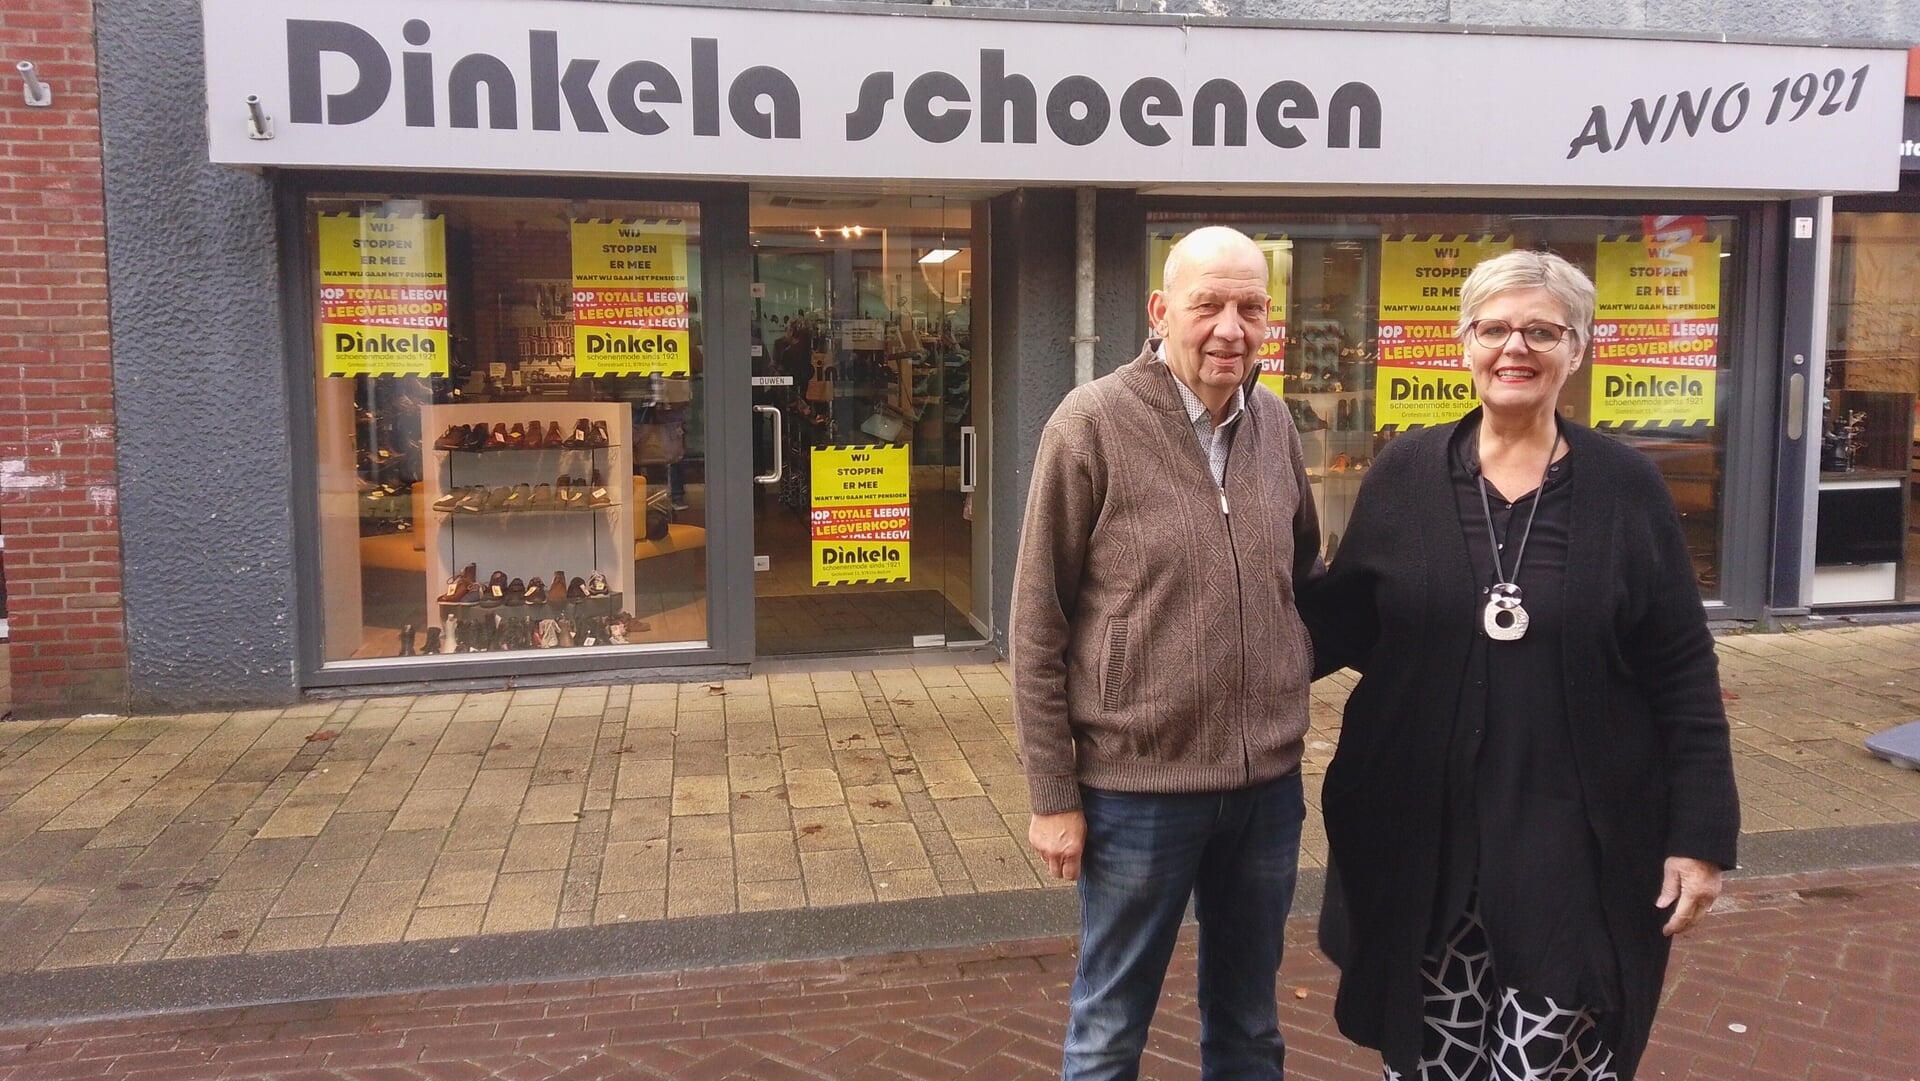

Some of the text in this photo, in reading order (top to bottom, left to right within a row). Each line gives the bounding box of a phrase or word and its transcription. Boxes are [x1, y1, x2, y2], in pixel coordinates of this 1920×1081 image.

[286, 18, 1382, 149] Dinkela schoenen
[1566, 64, 1870, 160] ANNO 1921
[370, 223, 394, 232] WIJ
[618, 229, 641, 238] WIJ
[353, 239, 413, 249] STOPPEN
[602, 245, 657, 253] STOPPEN
[1434, 248, 1460, 258] WIJ
[1648, 248, 1672, 258] WIJ
[360, 256, 406, 265] ER MEE
[610, 260, 651, 269] ER MEE
[1630, 267, 1688, 277] STOPPEN
[346, 289, 398, 300] TOTALE
[1423, 287, 1460, 297] ER ME
[1636, 286, 1680, 296] ER MEE
[597, 292, 644, 303] TOTALE
[327, 303, 443, 318] LEEGVERKOOP
[580, 305, 685, 320] LEEGVERKOOP
[1619, 324, 1670, 336] TOTALE
[1600, 338, 1713, 357] LEEGVERKOOP
[587, 353, 640, 361] schoenenmode
[760, 377, 784, 385] DUWEN
[837, 467, 884, 476] STOPPEN
[858, 481, 878, 489] MEE
[831, 509, 872, 519] TOTALE
[816, 519, 907, 536] LEEGVERKOOP
